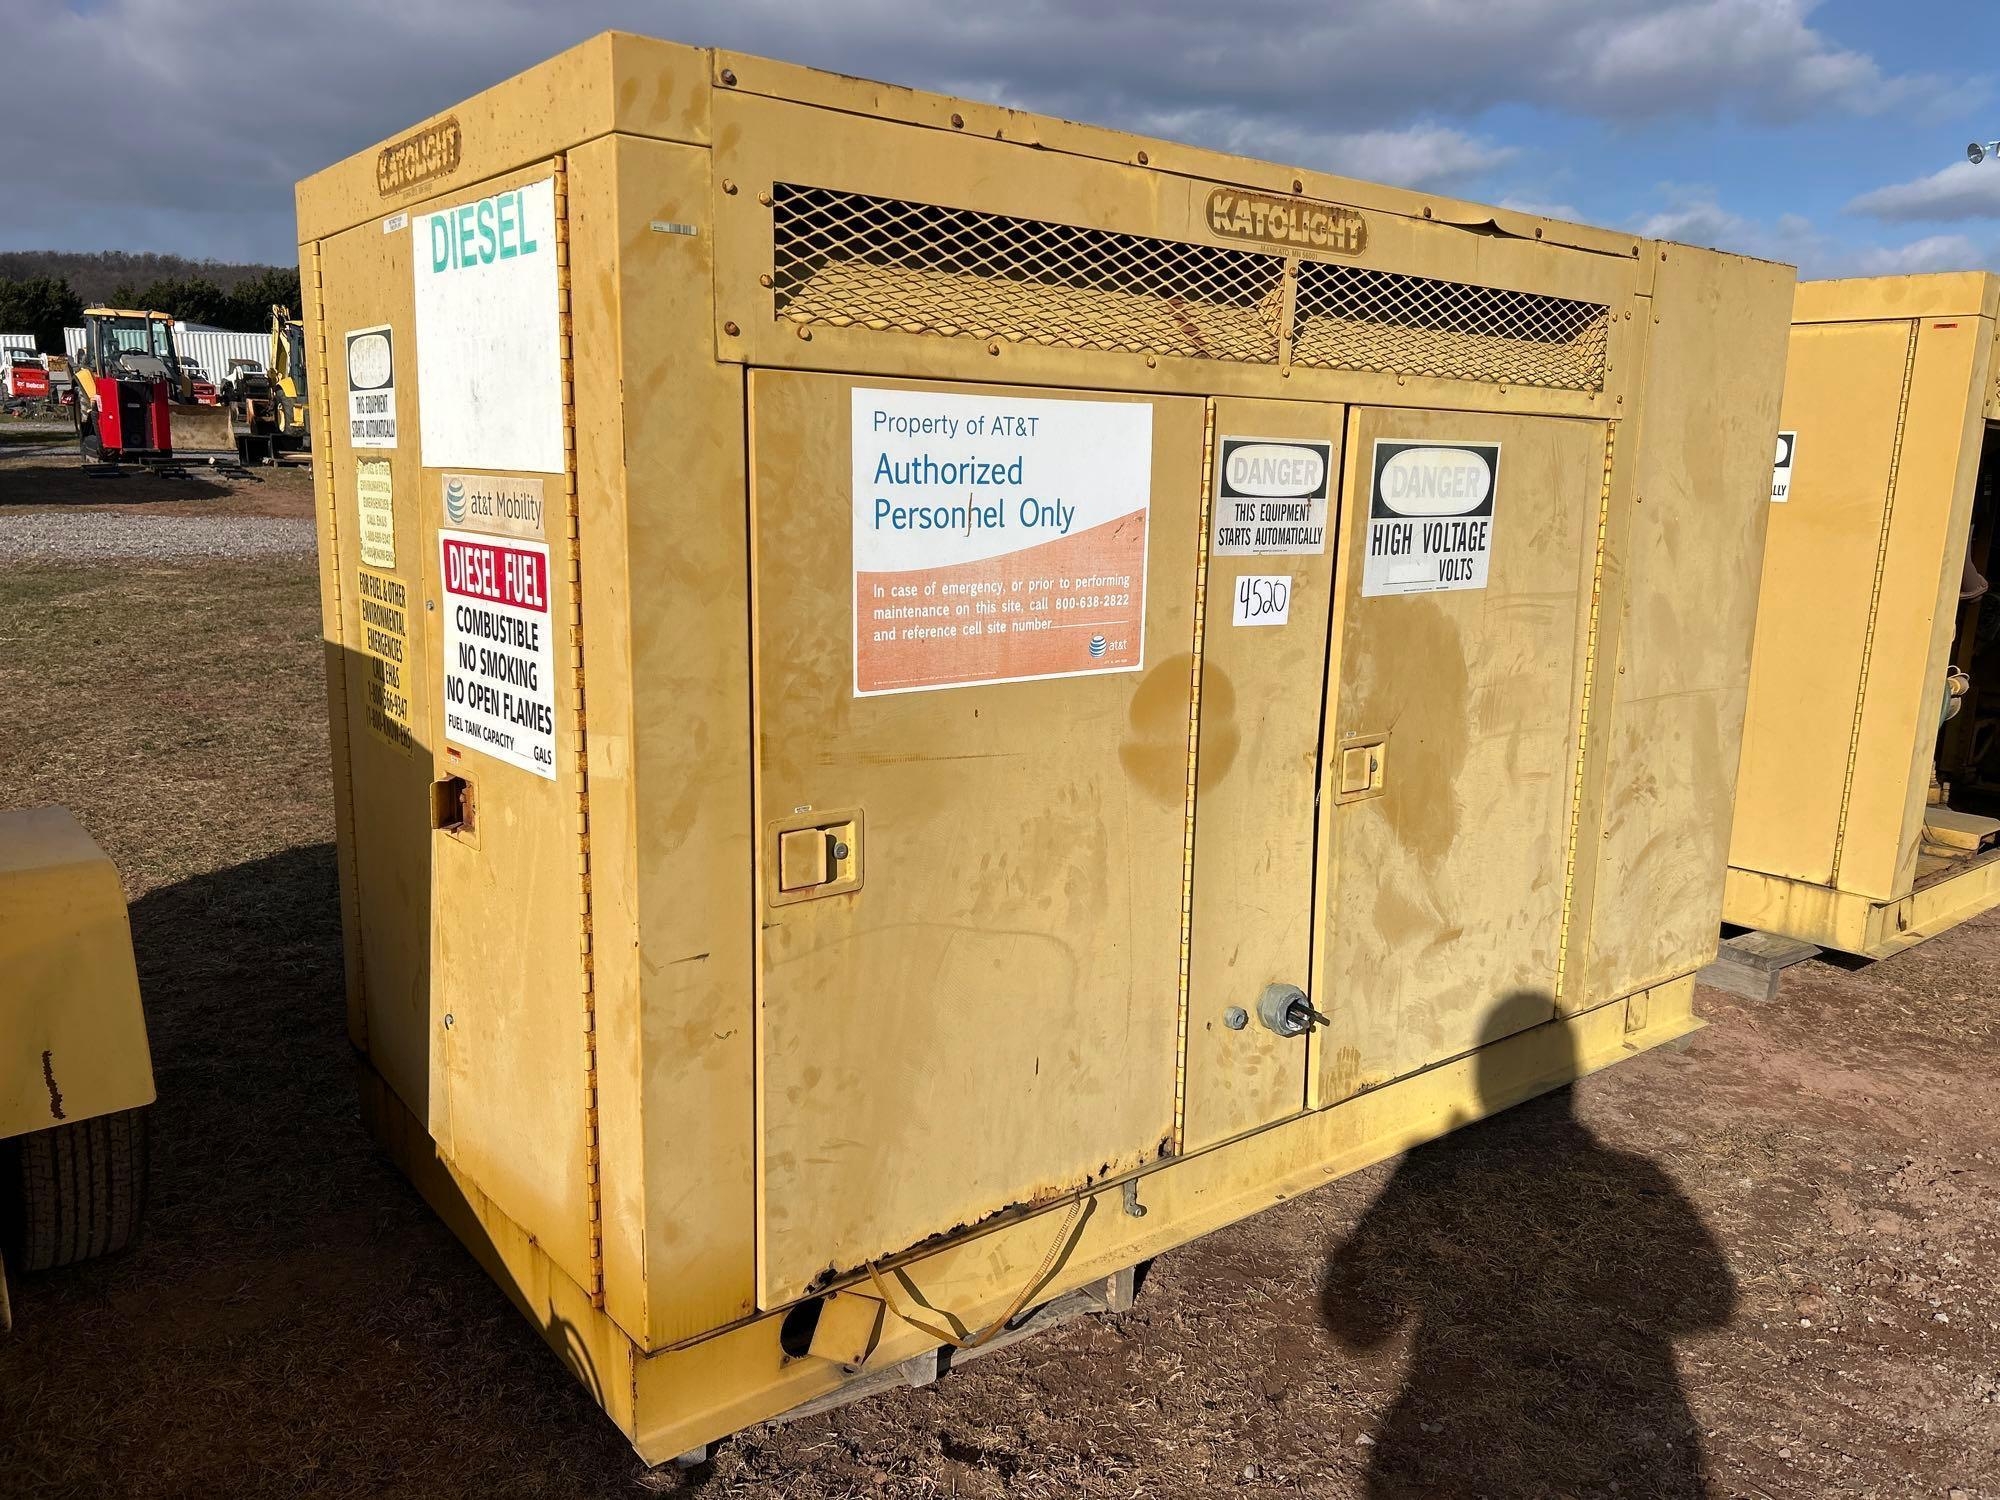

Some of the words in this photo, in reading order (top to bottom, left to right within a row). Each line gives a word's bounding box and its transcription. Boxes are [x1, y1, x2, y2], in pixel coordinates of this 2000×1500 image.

[431, 192, 536, 273] DIESEL
[1213, 194, 1363, 250] KATOLIGHT
[25, 381, 45, 389] Bobcat
[355, 396, 365, 414] THIS
[365, 394, 388, 413] EQUIPMENT
[352, 420, 364, 437] STARTS
[366, 419, 395, 437] AUTOMATICALLY
[873, 410, 959, 438] Property
[966, 415, 985, 435] of
[991, 416, 1039, 437] AT&T
[873, 452, 1023, 485] Authorized
[1233, 456, 1318, 486] DANGER
[1391, 465, 1481, 498] DANGER
[470, 491, 493, 516] at&t
[496, 494, 542, 530] Mobility
[874, 498, 1005, 530] Personnel
[1019, 498, 1075, 534] Only
[1235, 503, 1255, 522] THIS
[1260, 503, 1311, 522] EQUIPMENT
[1218, 527, 1251, 546] STARTS
[1255, 526, 1323, 546] AUTOMATICALLY
[1371, 523, 1413, 556] HIGH
[1422, 521, 1488, 554] VOLTAGE
[449, 544, 501, 599] DIESEL
[504, 553, 544, 607] FUEL
[873, 583, 885, 598] In
[891, 585, 917, 598] case
[924, 582, 936, 596] of
[942, 581, 1006, 597] emergency,
[1011, 580, 1023, 590] or
[1028, 576, 1054, 594] prior
[1059, 576, 1070, 589] to
[1075, 574, 1130, 591] performing
[1438, 558, 1473, 583] VOLTS
[360, 572, 370, 597] FOR
[369, 575, 382, 601] FUEL
[382, 579, 388, 602] &
[388, 580, 407, 609] OTHER
[873, 603, 950, 620] maintenance
[955, 604, 970, 616] on
[975, 600, 997, 614] this
[1001, 599, 1024, 613] site,
[1030, 597, 1049, 612] call
[1055, 594, 1129, 610] 800-638-2822
[1239, 578, 1287, 619] 4520
[362, 599, 406, 637] ENVIRONMENTAL
[456, 605, 539, 652] COMBUSTIBLE
[873, 627, 896, 642] and
[902, 625, 957, 640] reference
[962, 621, 982, 636] cell
[987, 620, 1007, 634] site
[1011, 618, 1053, 633] number
[367, 627, 403, 663] EMERGENCIES
[1108, 638, 1128, 651] at&t
[372, 656, 385, 683] CALL
[458, 642, 477, 672] NO
[480, 648, 538, 692] SMOKING
[447, 674, 465, 702] NO
[467, 681, 500, 717] OPEN
[503, 693, 552, 736] FLAMES
[448, 713, 463, 732] FUEL
[465, 719, 482, 741] TANK
[482, 726, 515, 751] CAPACITY
[533, 745, 552, 766] GALS
